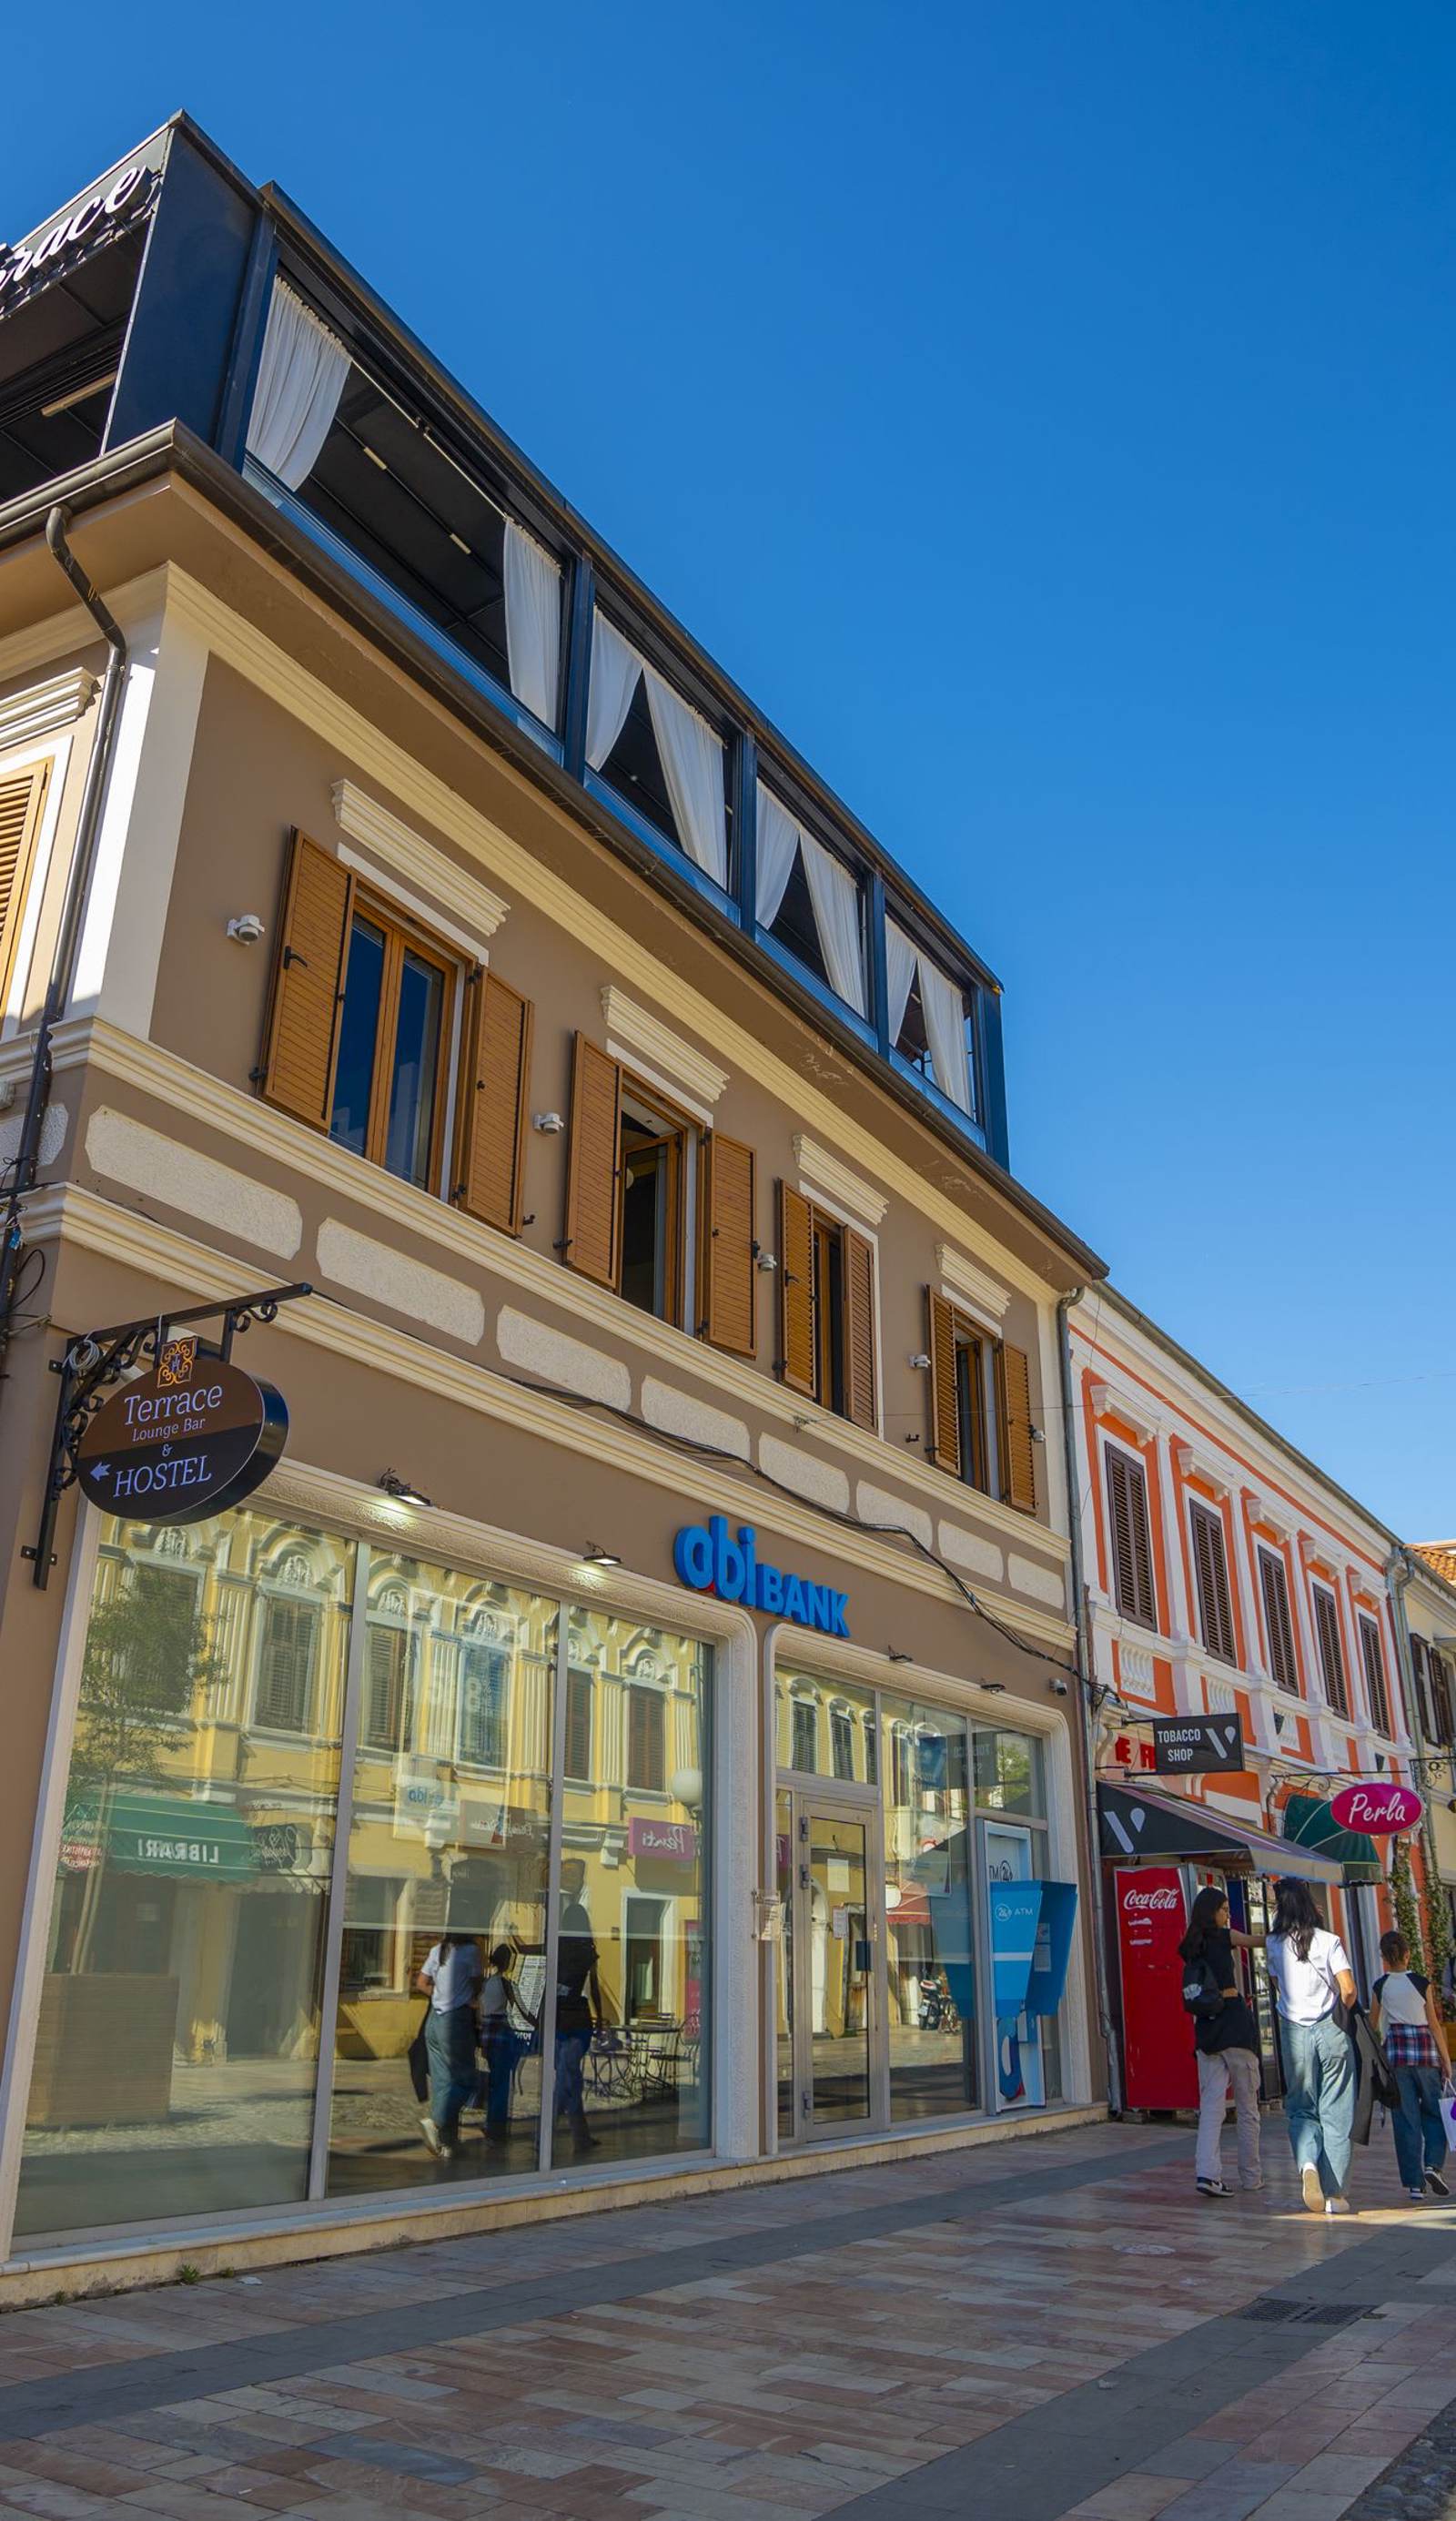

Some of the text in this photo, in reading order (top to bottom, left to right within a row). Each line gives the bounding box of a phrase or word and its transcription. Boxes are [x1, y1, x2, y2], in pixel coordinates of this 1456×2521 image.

[124, 1385, 223, 1426] Terrace
[132, 1417, 206, 1442] Lounge Bar
[162, 1443, 173, 1456] &
[113, 1455, 212, 1498] HOSTEL
[755, 1563, 851, 1638] BANK
[1158, 1729, 1201, 1744] TOBACCO
[1168, 1748, 1194, 1763] SHOP
[1349, 1792, 1406, 1824] Perla
[1014, 1908, 1034, 1916] ATM
